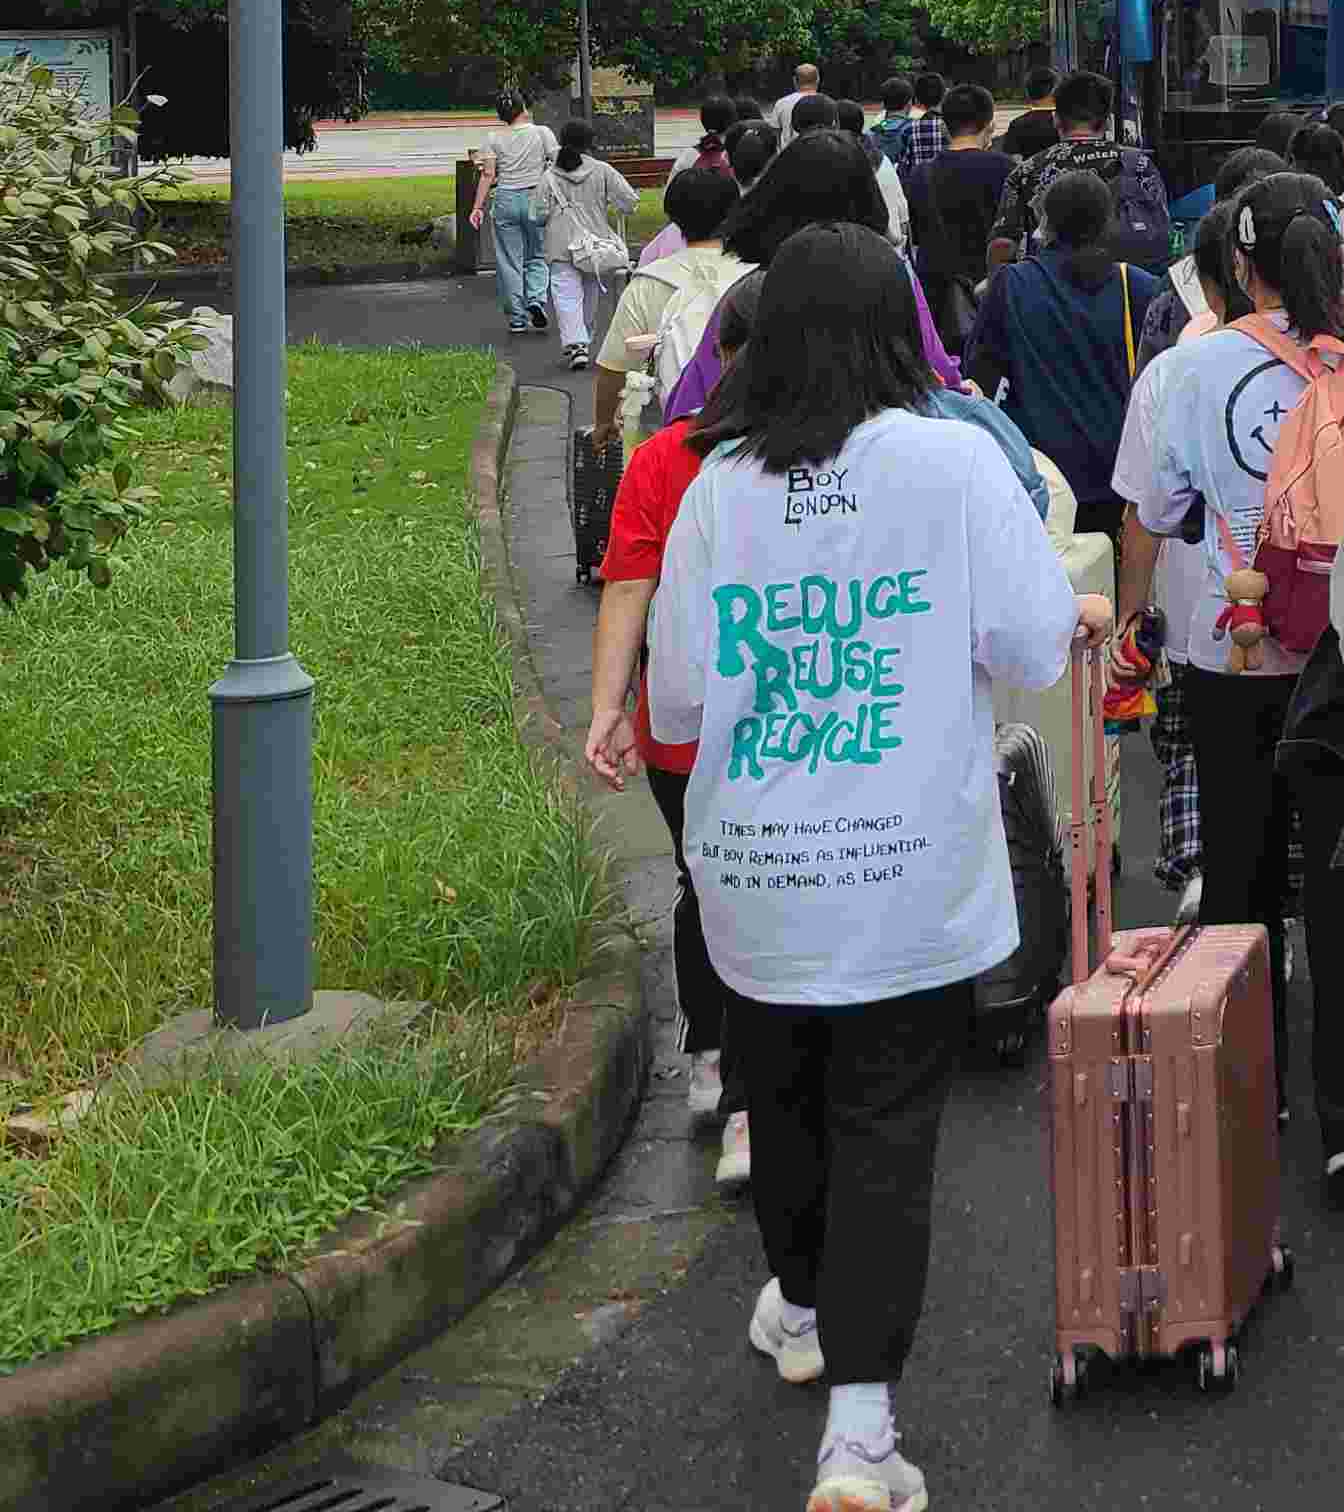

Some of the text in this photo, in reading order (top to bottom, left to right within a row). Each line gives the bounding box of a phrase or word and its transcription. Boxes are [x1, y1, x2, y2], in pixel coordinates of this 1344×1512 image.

[788, 468, 848, 492] BOY
[785, 494, 857, 524] LONDON
[712, 568, 932, 677] REDUCE
[751, 638, 905, 713] REUSE
[727, 701, 903, 781] RECYCLE
[720, 815, 903, 837] TIMES MAY HAVE CHANGED
[702, 837, 933, 866] BUT BOY REMAINS AS INFLUENTIAL
[720, 872, 741, 888] AND
[746, 872, 761, 888] IN
[837, 872, 856, 886] AS
[863, 864, 904, 883] EVER
